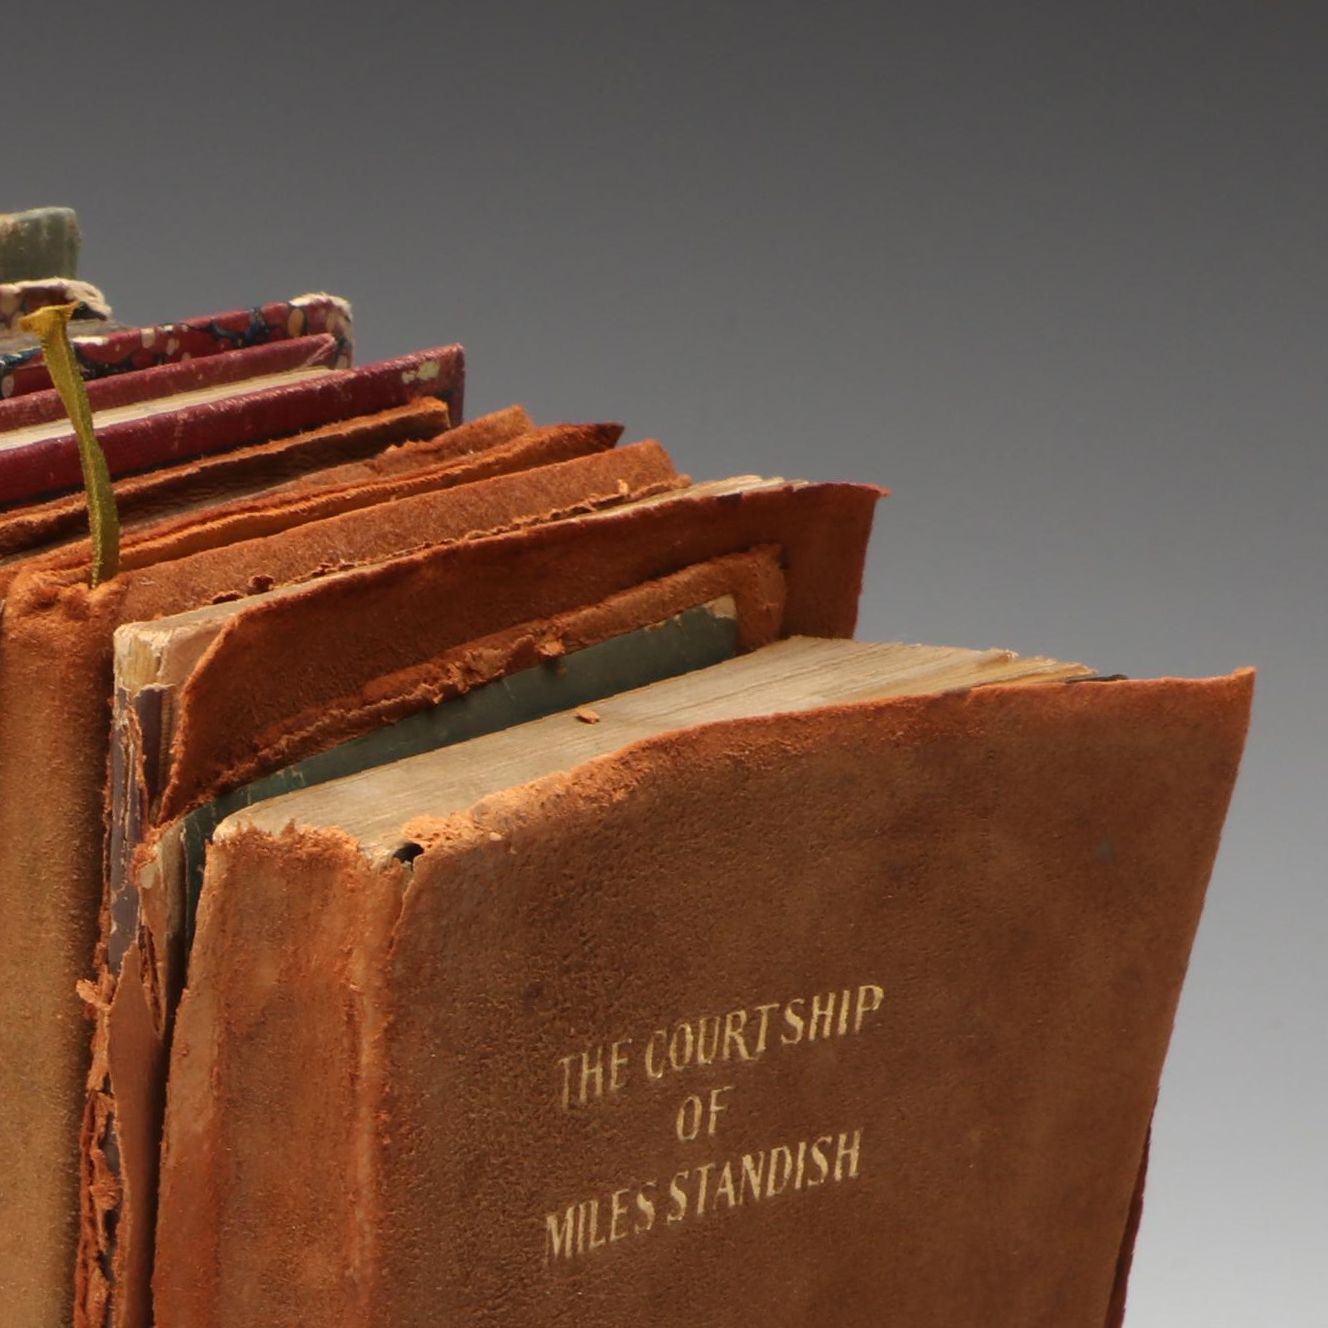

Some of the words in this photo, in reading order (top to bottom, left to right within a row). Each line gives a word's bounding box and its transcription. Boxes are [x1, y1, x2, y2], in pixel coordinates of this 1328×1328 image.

[557, 1037, 633, 1111] THE
[644, 983, 885, 1079] COURTSHIP
[675, 1085, 735, 1142] OF
[543, 1178, 657, 1268] MILES
[666, 1127, 865, 1226] STANDISH
